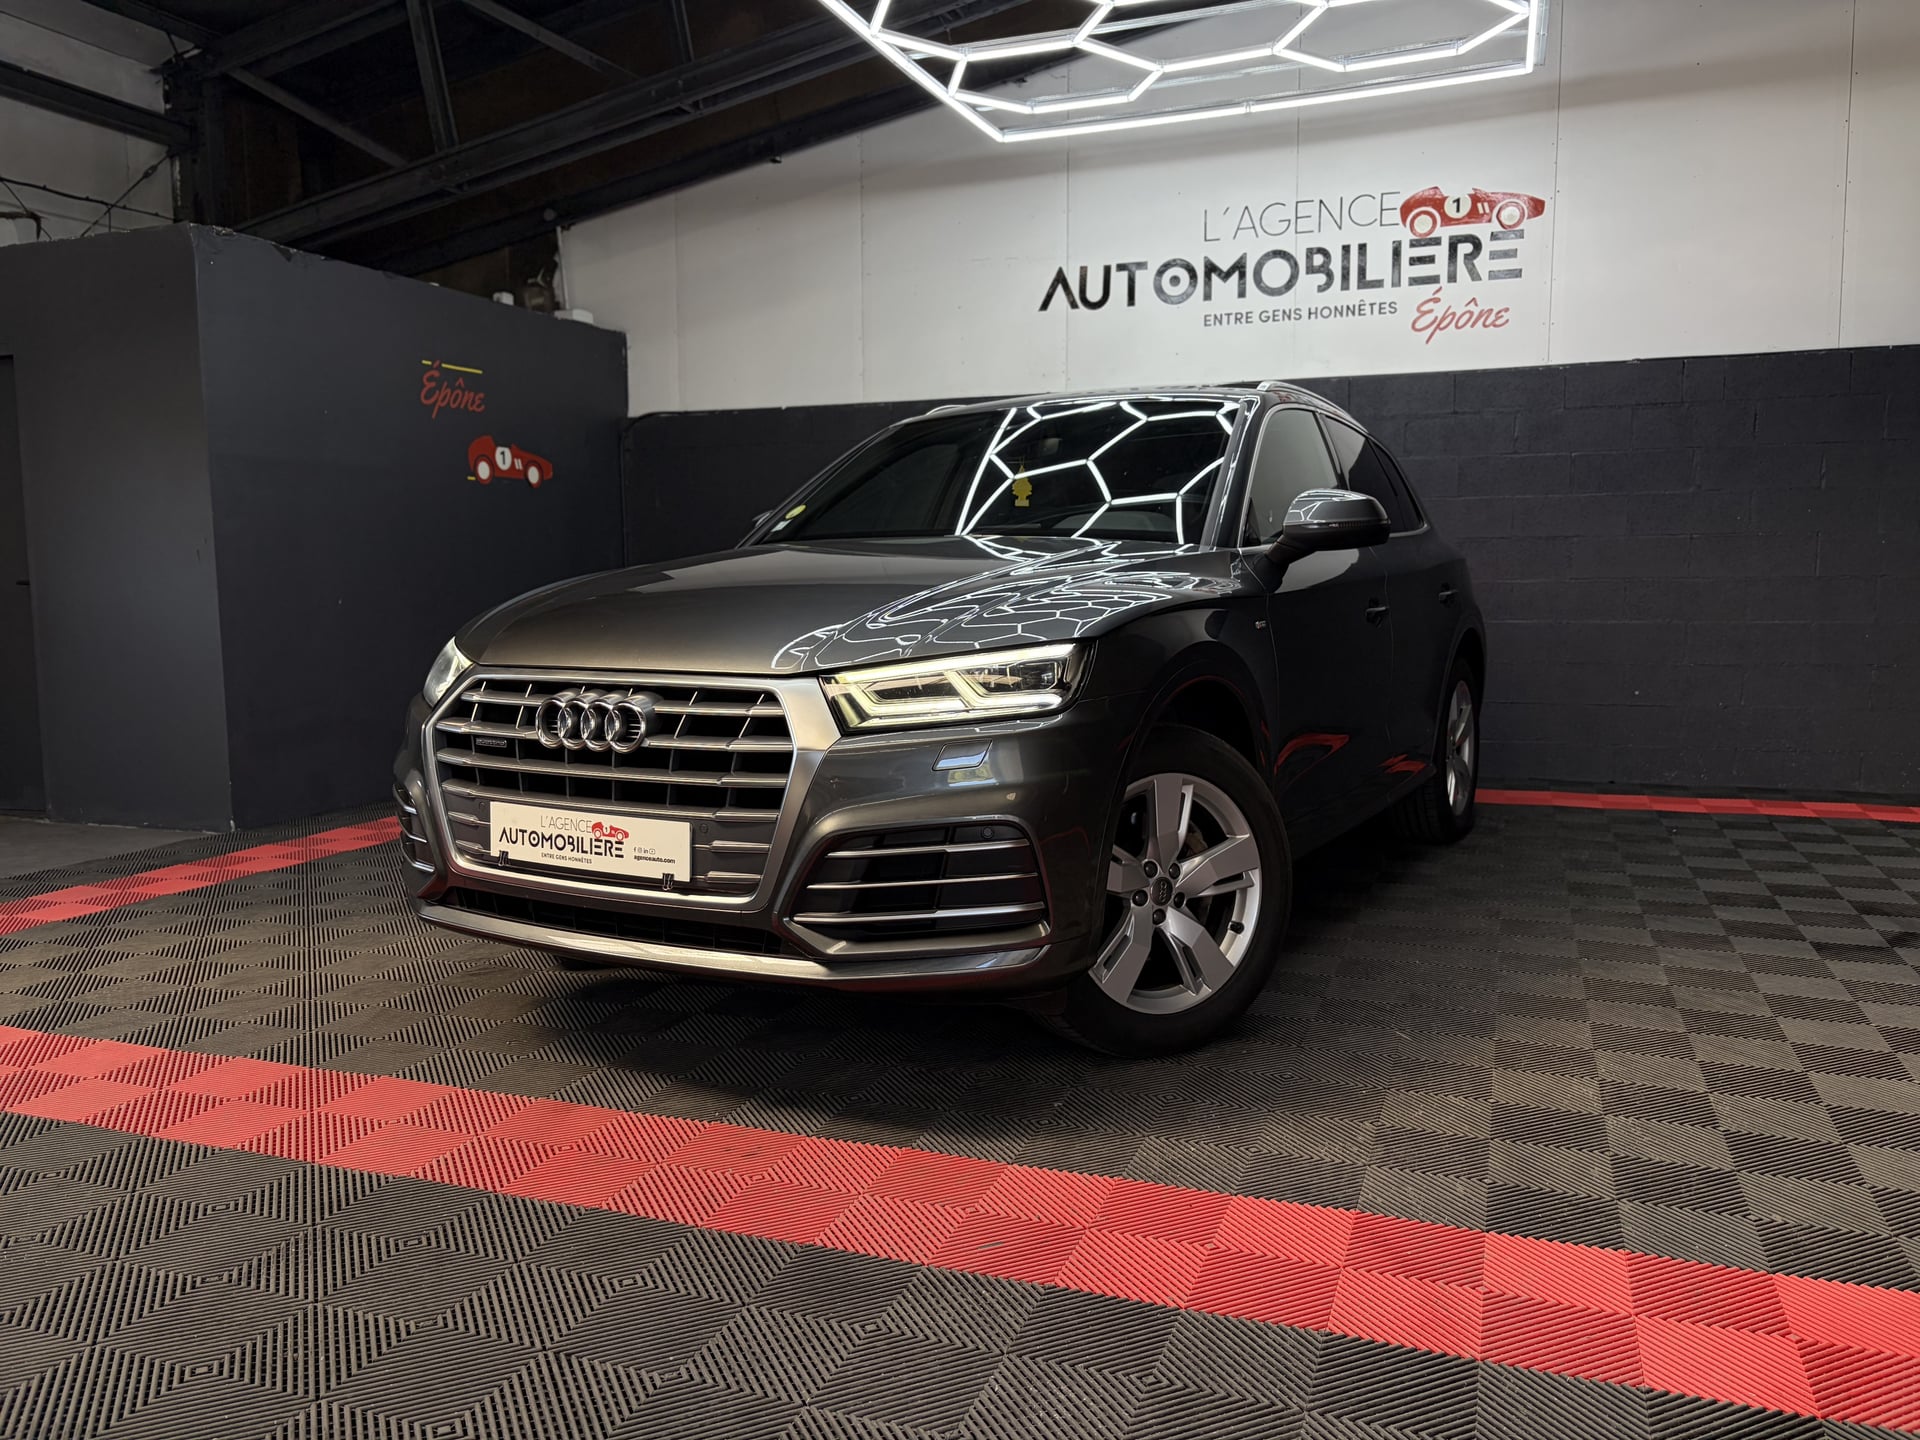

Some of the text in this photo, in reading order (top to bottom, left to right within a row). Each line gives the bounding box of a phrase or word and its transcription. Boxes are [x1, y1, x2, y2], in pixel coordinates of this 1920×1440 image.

[1038, 229, 1525, 312] AUTOMOBILIERE
[1203, 299, 1398, 327] ENTRE GENS HONNÊTES
[1411, 286, 1510, 344] Épône
[420, 360, 486, 419] Épône
[499, 826, 624, 858] AUTOMOBILIERE
